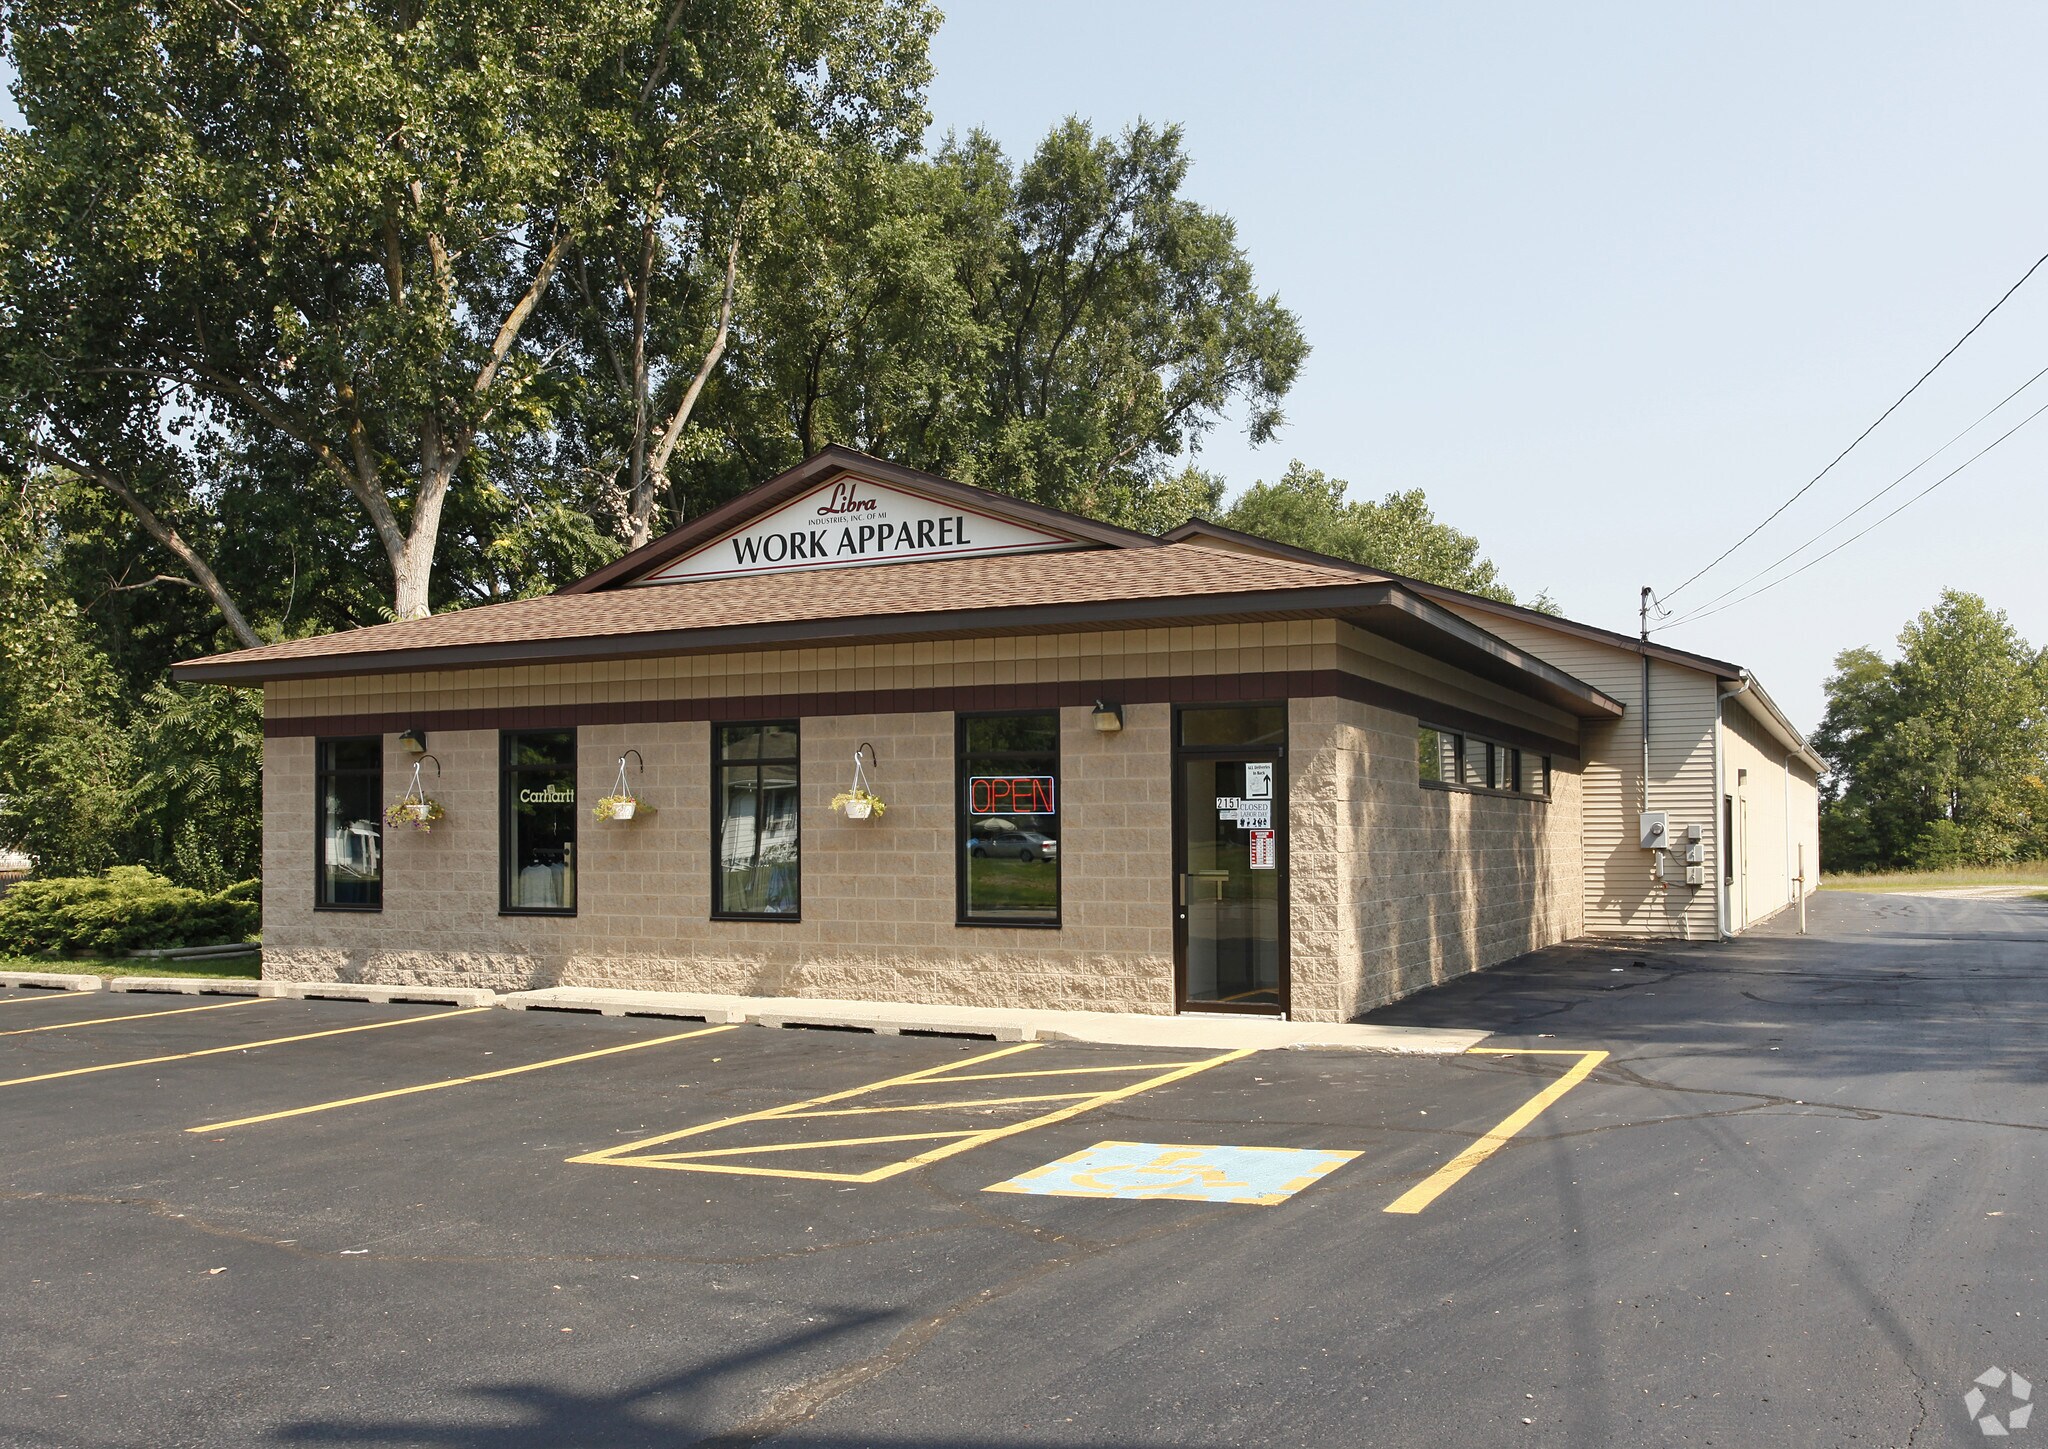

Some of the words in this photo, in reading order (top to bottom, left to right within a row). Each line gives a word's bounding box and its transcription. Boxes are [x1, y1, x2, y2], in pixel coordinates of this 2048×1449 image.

[817, 483, 877, 516] Libra
[808, 516, 849, 526] INDUSTRIES,
[850, 514, 865, 522] INC.
[732, 530, 828, 565] WORK
[837, 516, 971, 556] APPAREL
[520, 789, 574, 803] Carhartt
[972, 778, 1054, 813] OPEN
[1217, 798, 1240, 808] 2151
[1240, 803, 1269, 811] CLOSED
